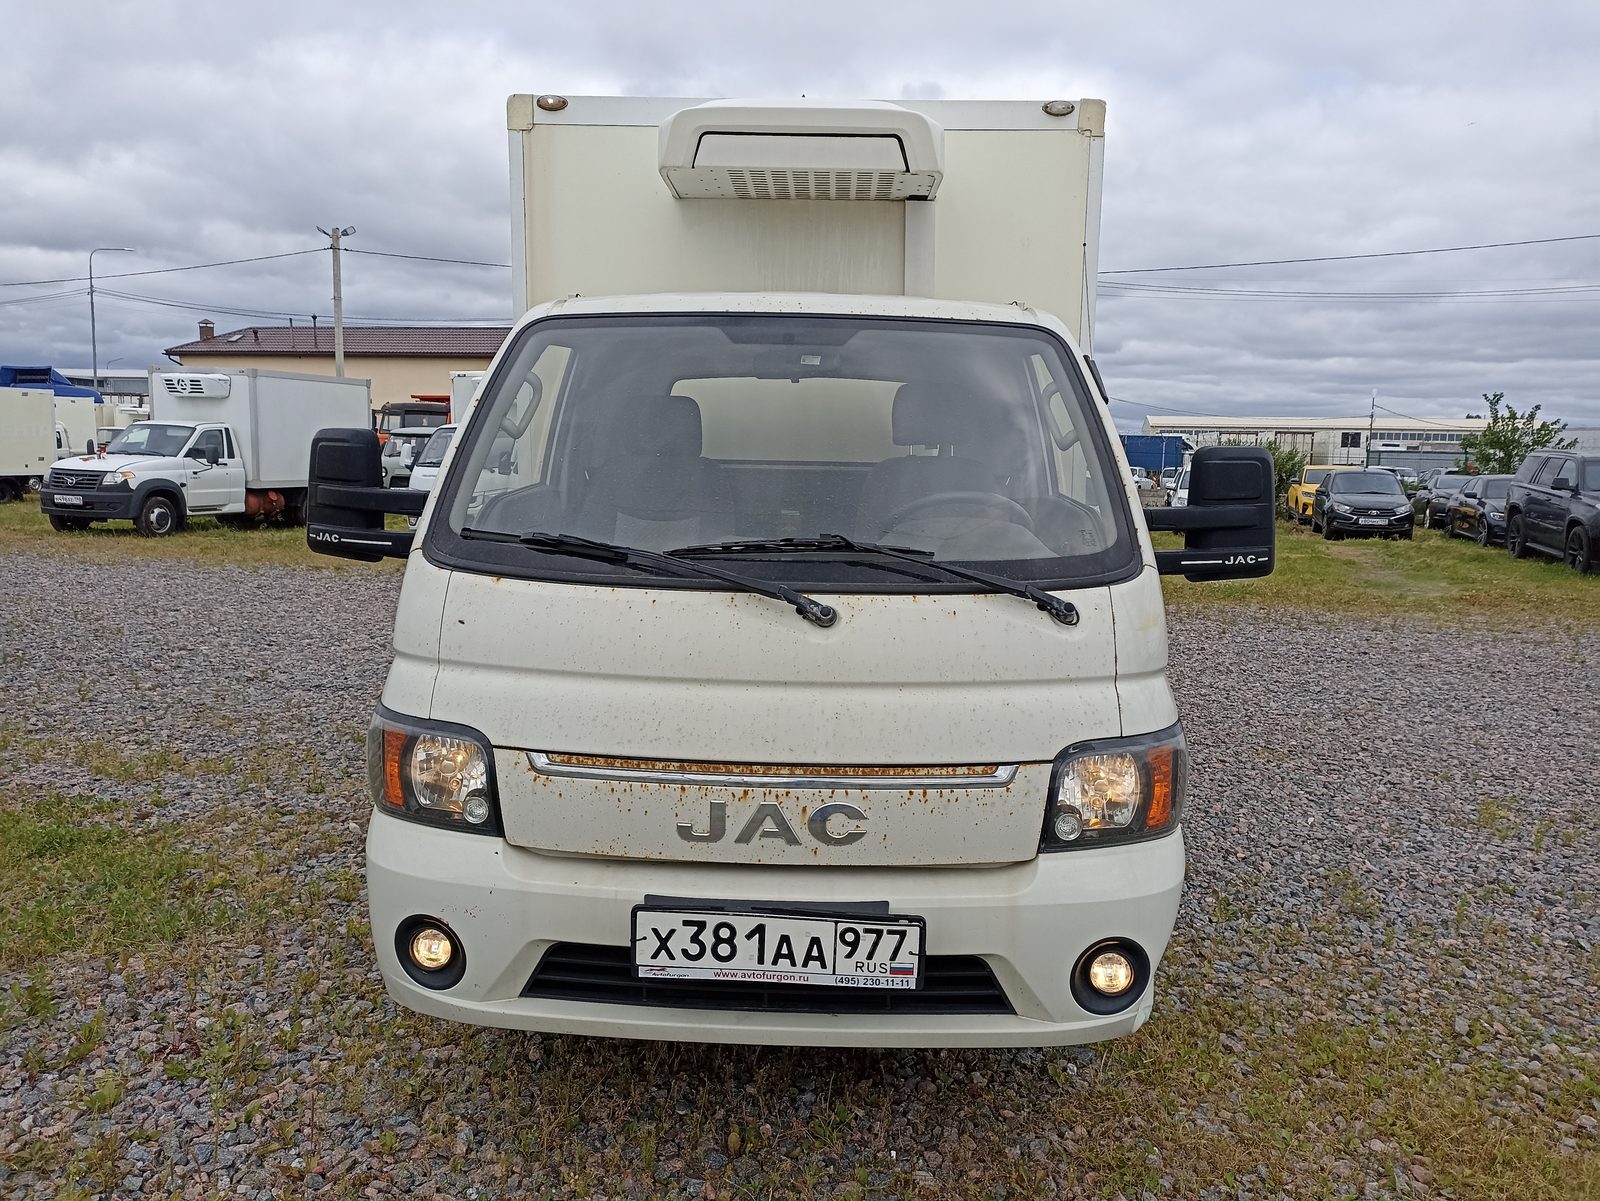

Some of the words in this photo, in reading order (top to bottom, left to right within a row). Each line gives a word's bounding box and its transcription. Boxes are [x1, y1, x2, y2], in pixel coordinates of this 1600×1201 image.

[317, 532, 340, 543] JAC
[1225, 555, 1256, 565] JAC
[677, 800, 869, 847] JAC
[838, 926, 908, 962] 977
[855, 961, 888, 974] RUS
[713, 970, 810, 984] www.avtofurgon.ru
[834, 976, 860, 986] (495)
[863, 977, 910, 988] 230-11-11
